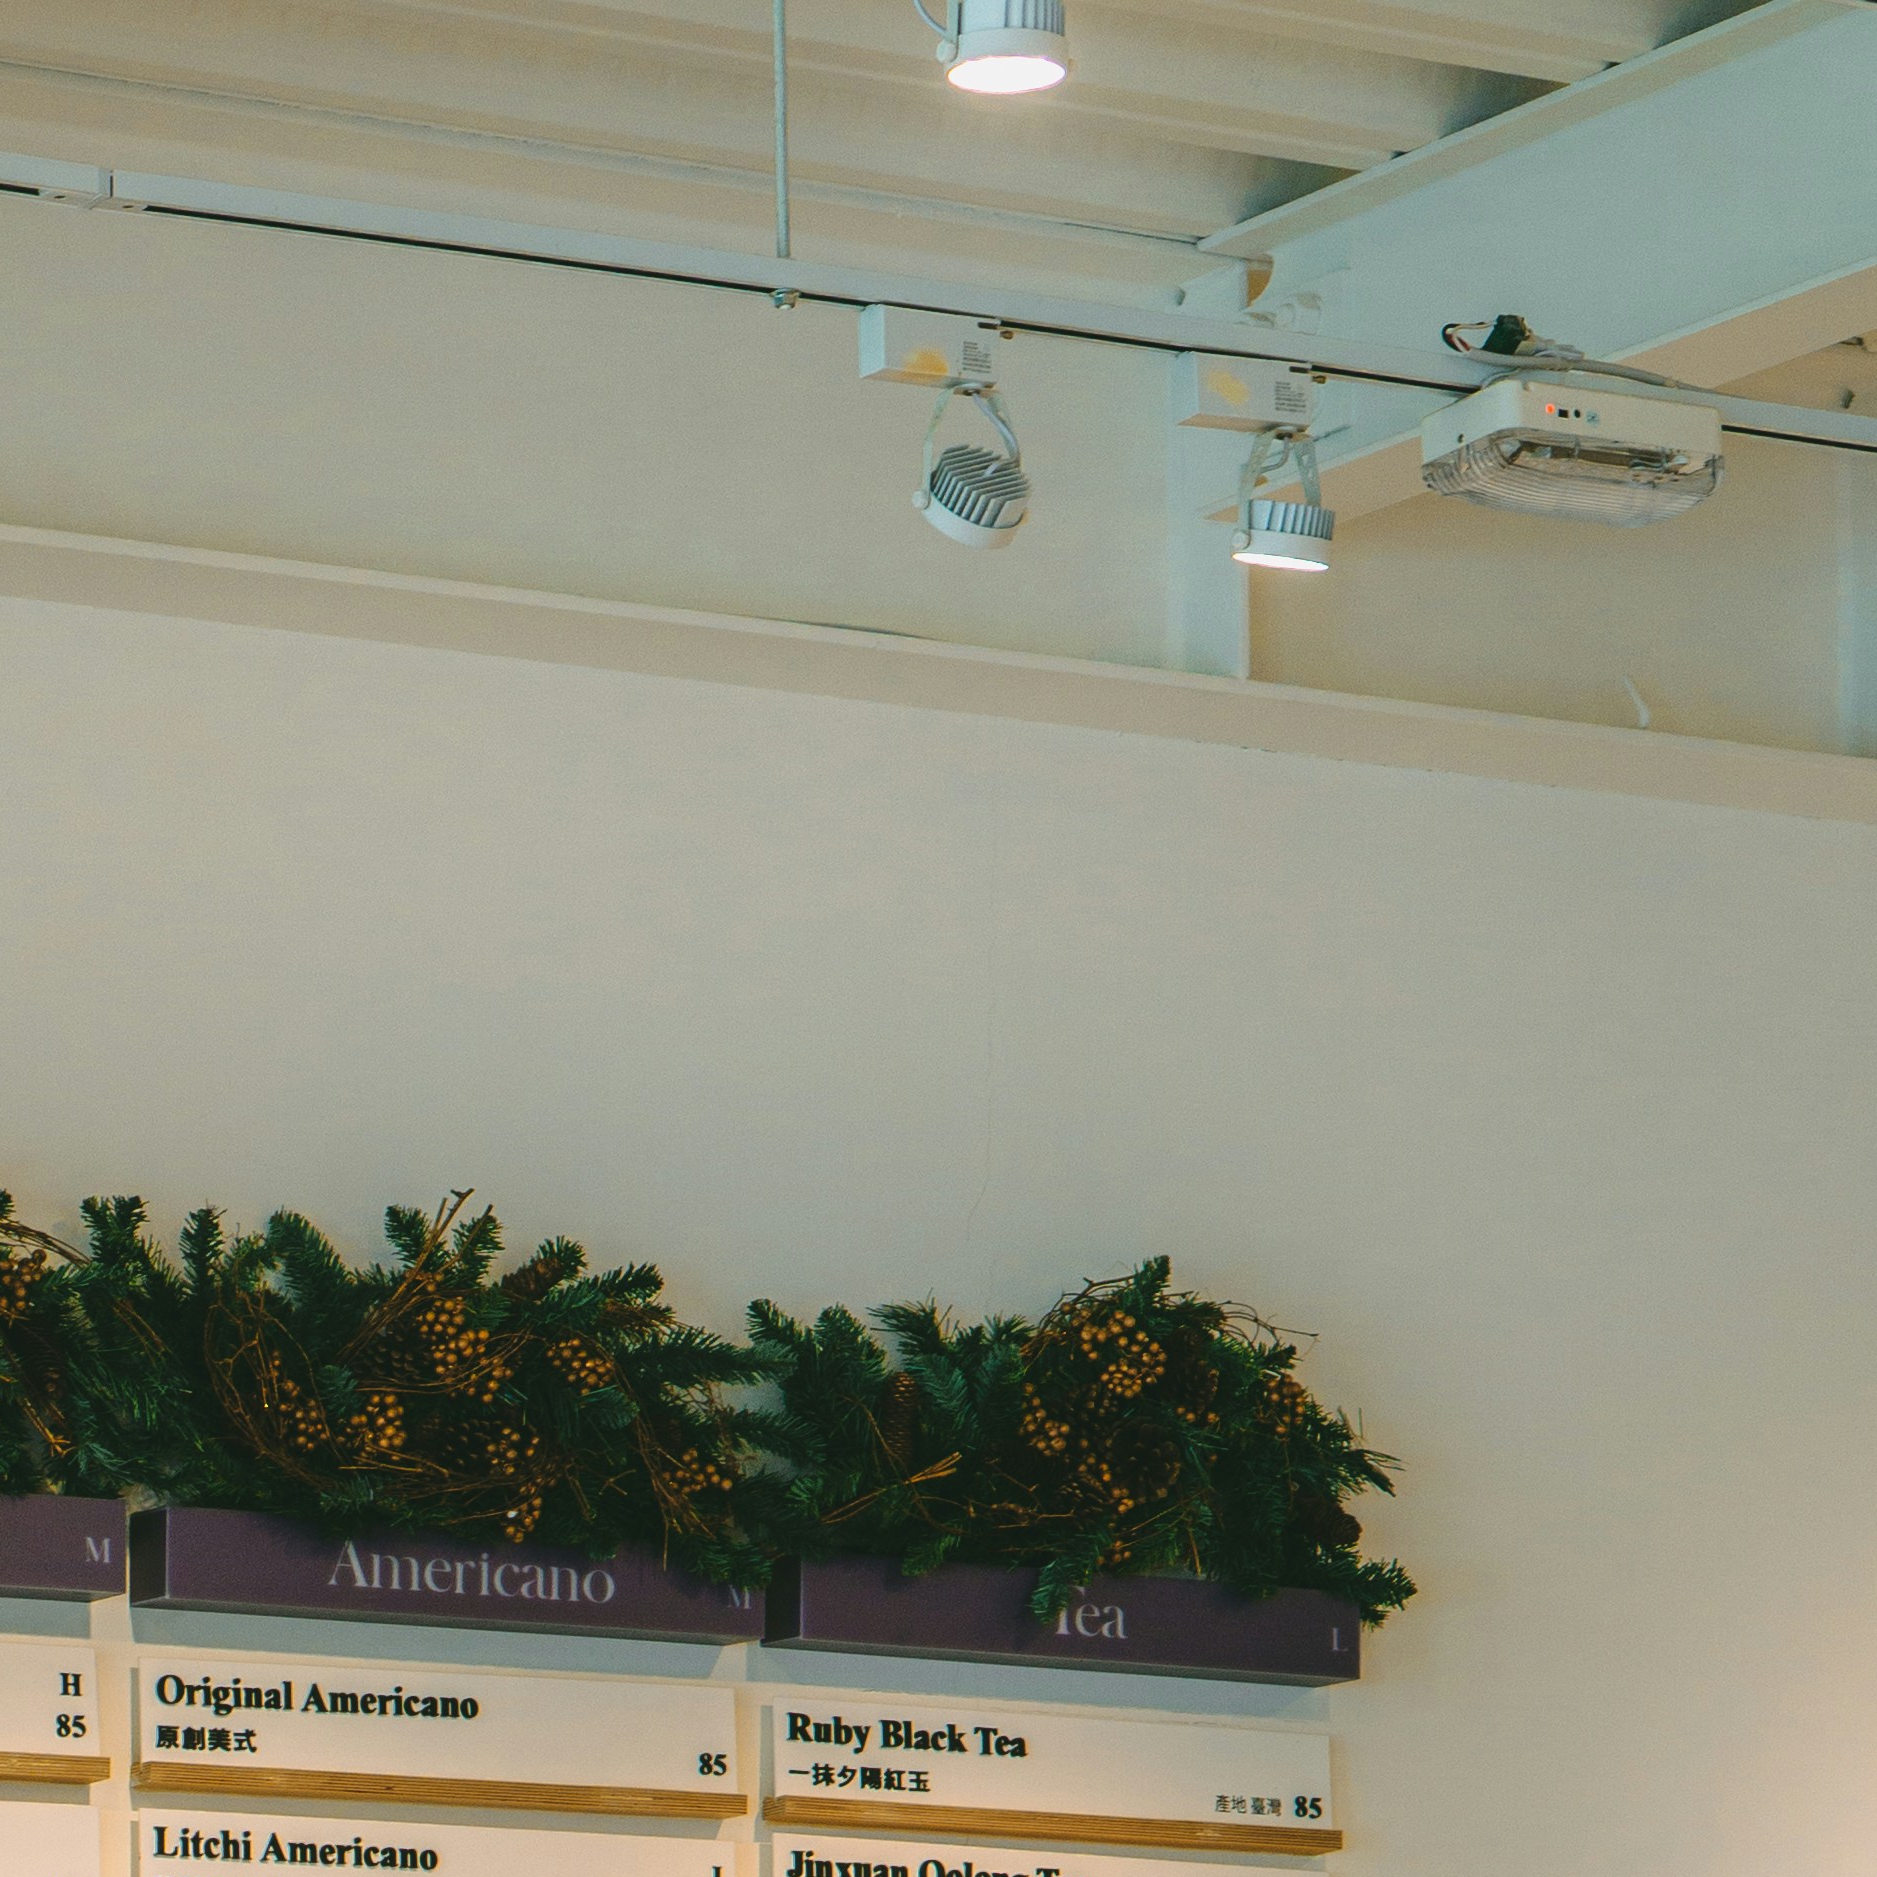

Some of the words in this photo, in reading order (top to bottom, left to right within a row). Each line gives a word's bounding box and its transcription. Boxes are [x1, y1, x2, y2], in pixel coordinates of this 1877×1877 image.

[328, 1543, 616, 1603] Americano
[156, 1674, 293, 1717] Original
[301, 1683, 479, 1720] Americano
[56, 1713, 87, 1739] 85
[156, 1725, 257, 1753] 原創美式
[787, 1712, 871, 1755] Ruby
[879, 1719, 967, 1753] Black
[973, 1726, 1027, 1758] Tea
[698, 1752, 727, 1776] 85
[788, 1762, 930, 1793] 一抹夕陽紅玉
[1294, 1795, 1323, 1820] 85
[154, 1826, 252, 1862] Litchi
[260, 1832, 439, 1871] Americano
